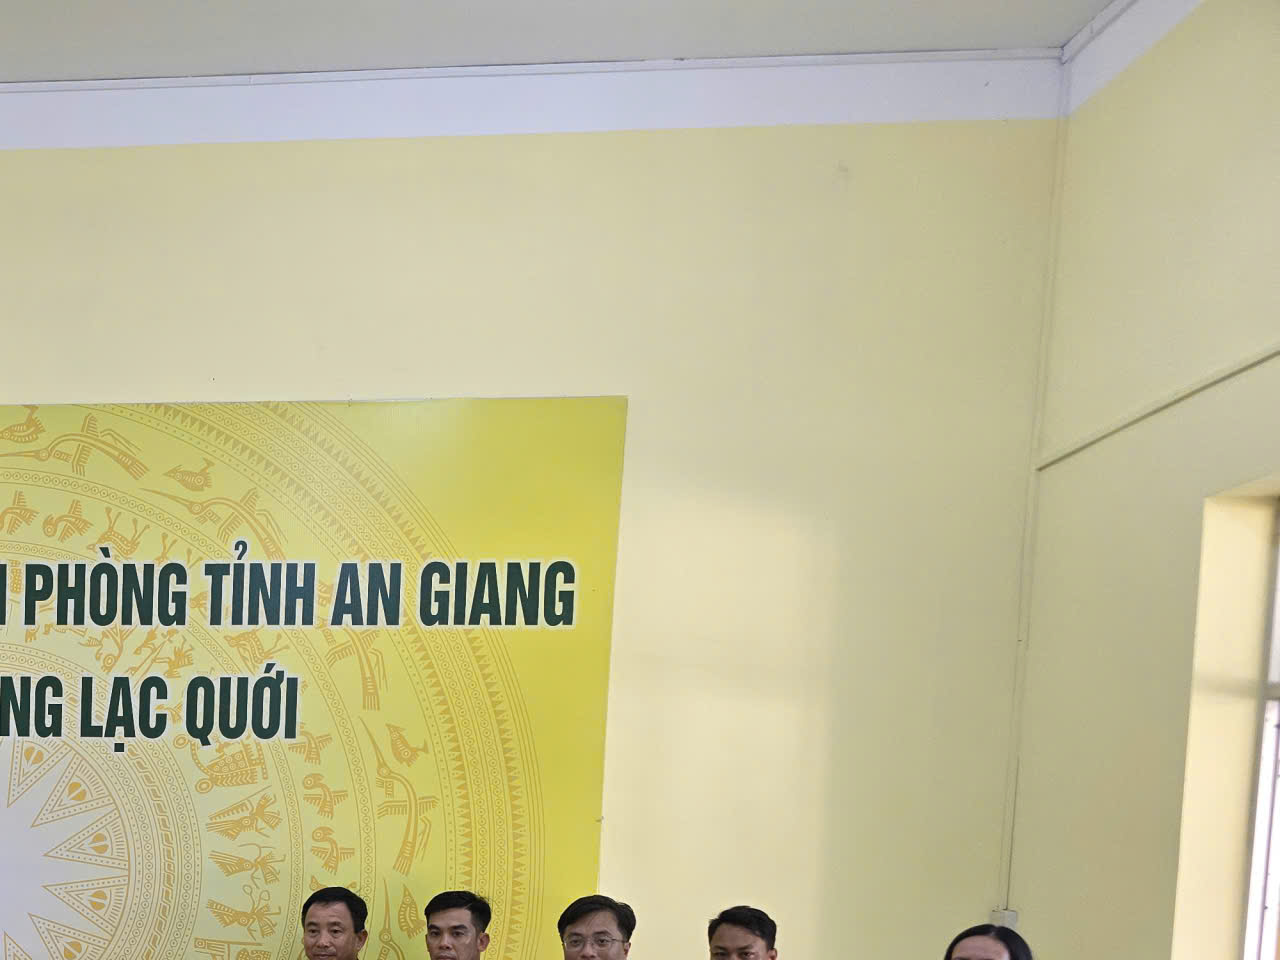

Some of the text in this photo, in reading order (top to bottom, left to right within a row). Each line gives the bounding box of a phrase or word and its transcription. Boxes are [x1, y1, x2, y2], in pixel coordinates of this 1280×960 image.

[24, 547, 187, 626] PHÒNG
[204, 540, 316, 626] TỈNH
[331, 562, 402, 626] AN
[419, 560, 575, 627] GIANG
[80, 675, 168, 752] LẠC
[185, 663, 298, 746] QUỚI
